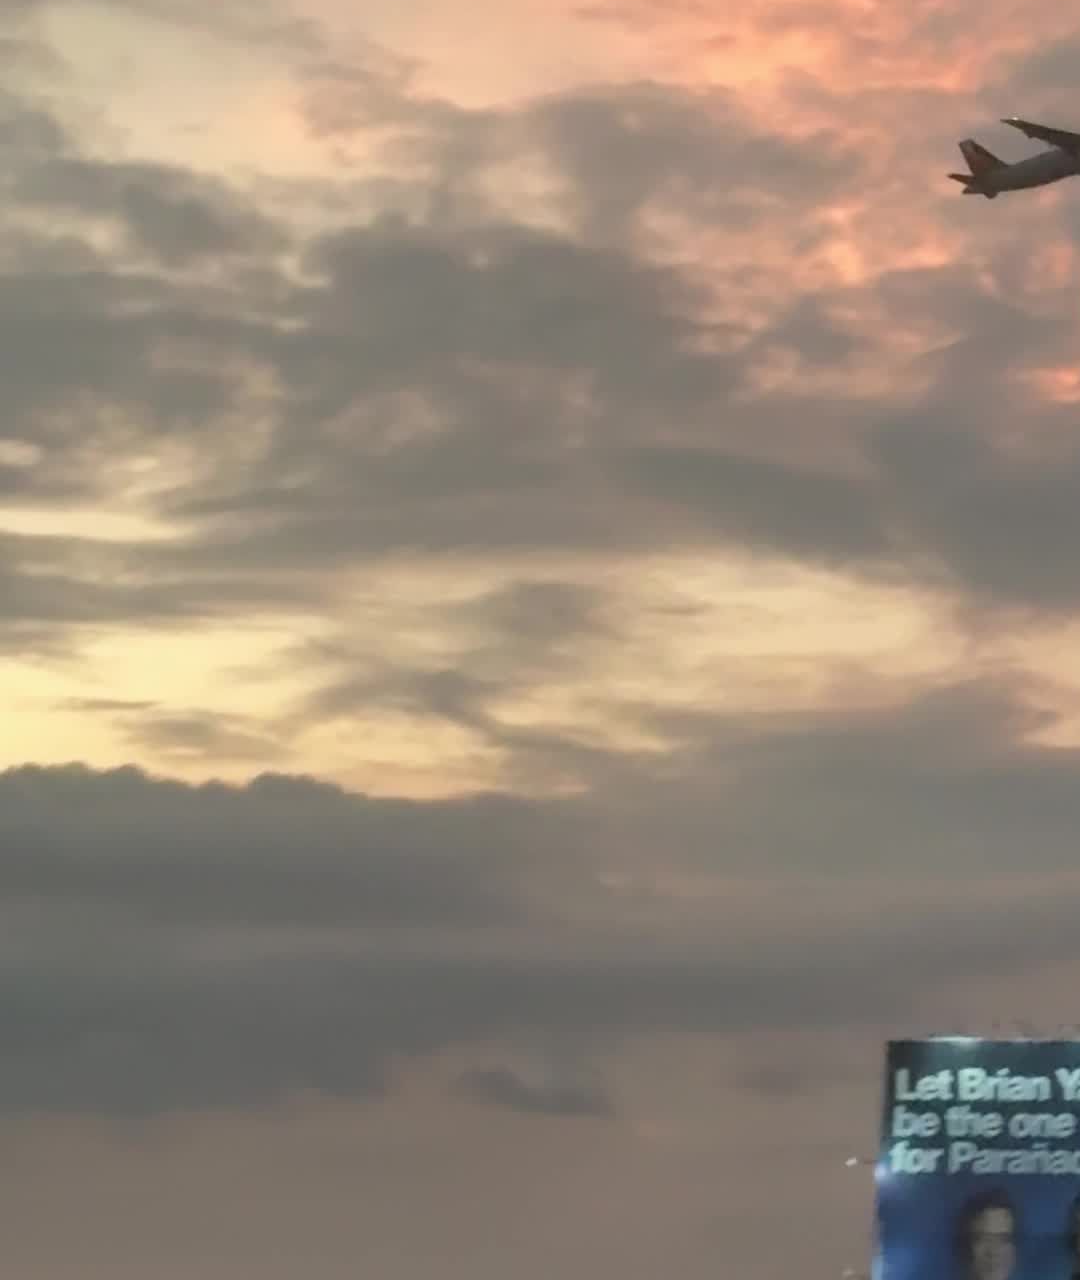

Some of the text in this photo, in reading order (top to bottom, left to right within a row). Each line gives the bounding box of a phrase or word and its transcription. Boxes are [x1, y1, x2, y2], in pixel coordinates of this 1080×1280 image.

[895, 1068, 953, 1101] Let
[957, 1067, 1050, 1101] Brian
[892, 1105, 1077, 1138] be the one
[889, 1141, 943, 1173] for
